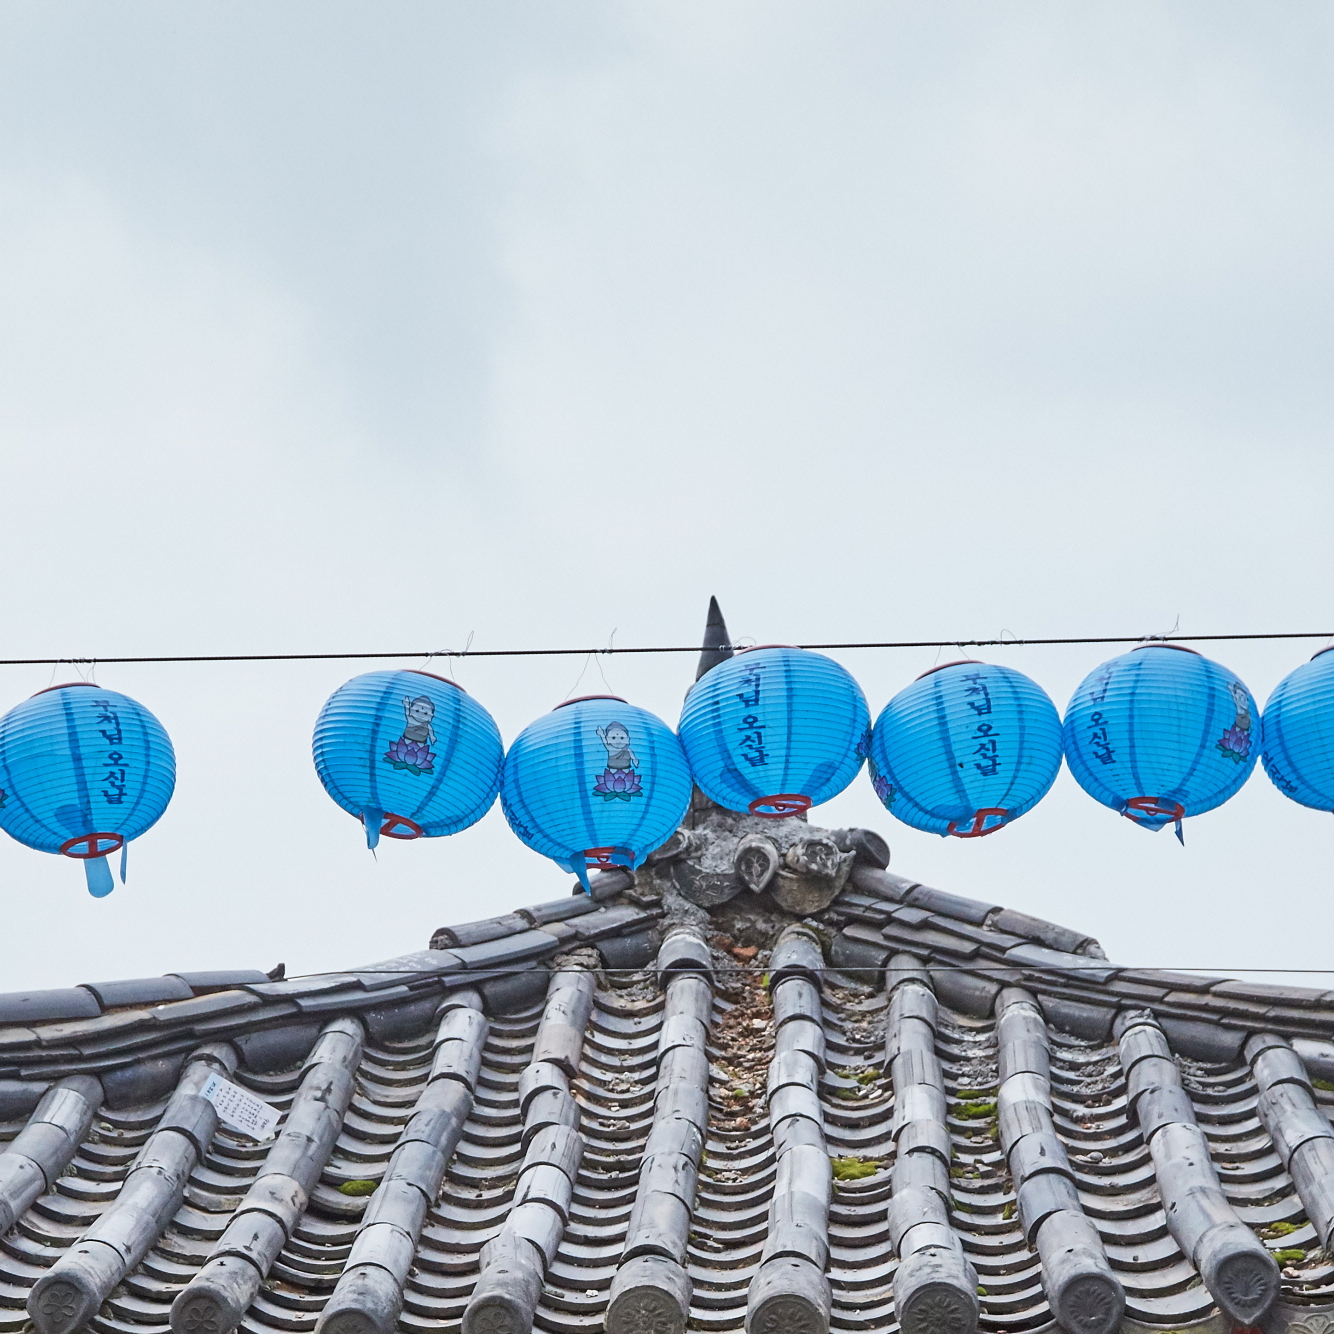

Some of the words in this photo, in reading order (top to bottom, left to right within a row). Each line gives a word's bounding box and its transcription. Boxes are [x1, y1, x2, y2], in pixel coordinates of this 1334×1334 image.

[736, 662, 767, 708] 부처님
[961, 672, 993, 717] 부처님
[91, 700, 123, 745] 부처님
[740, 713, 770, 767] 오신날
[971, 722, 1002, 776] 오신날
[1086, 711, 1117, 765] 오신날
[101, 751, 130, 804] 오신날
